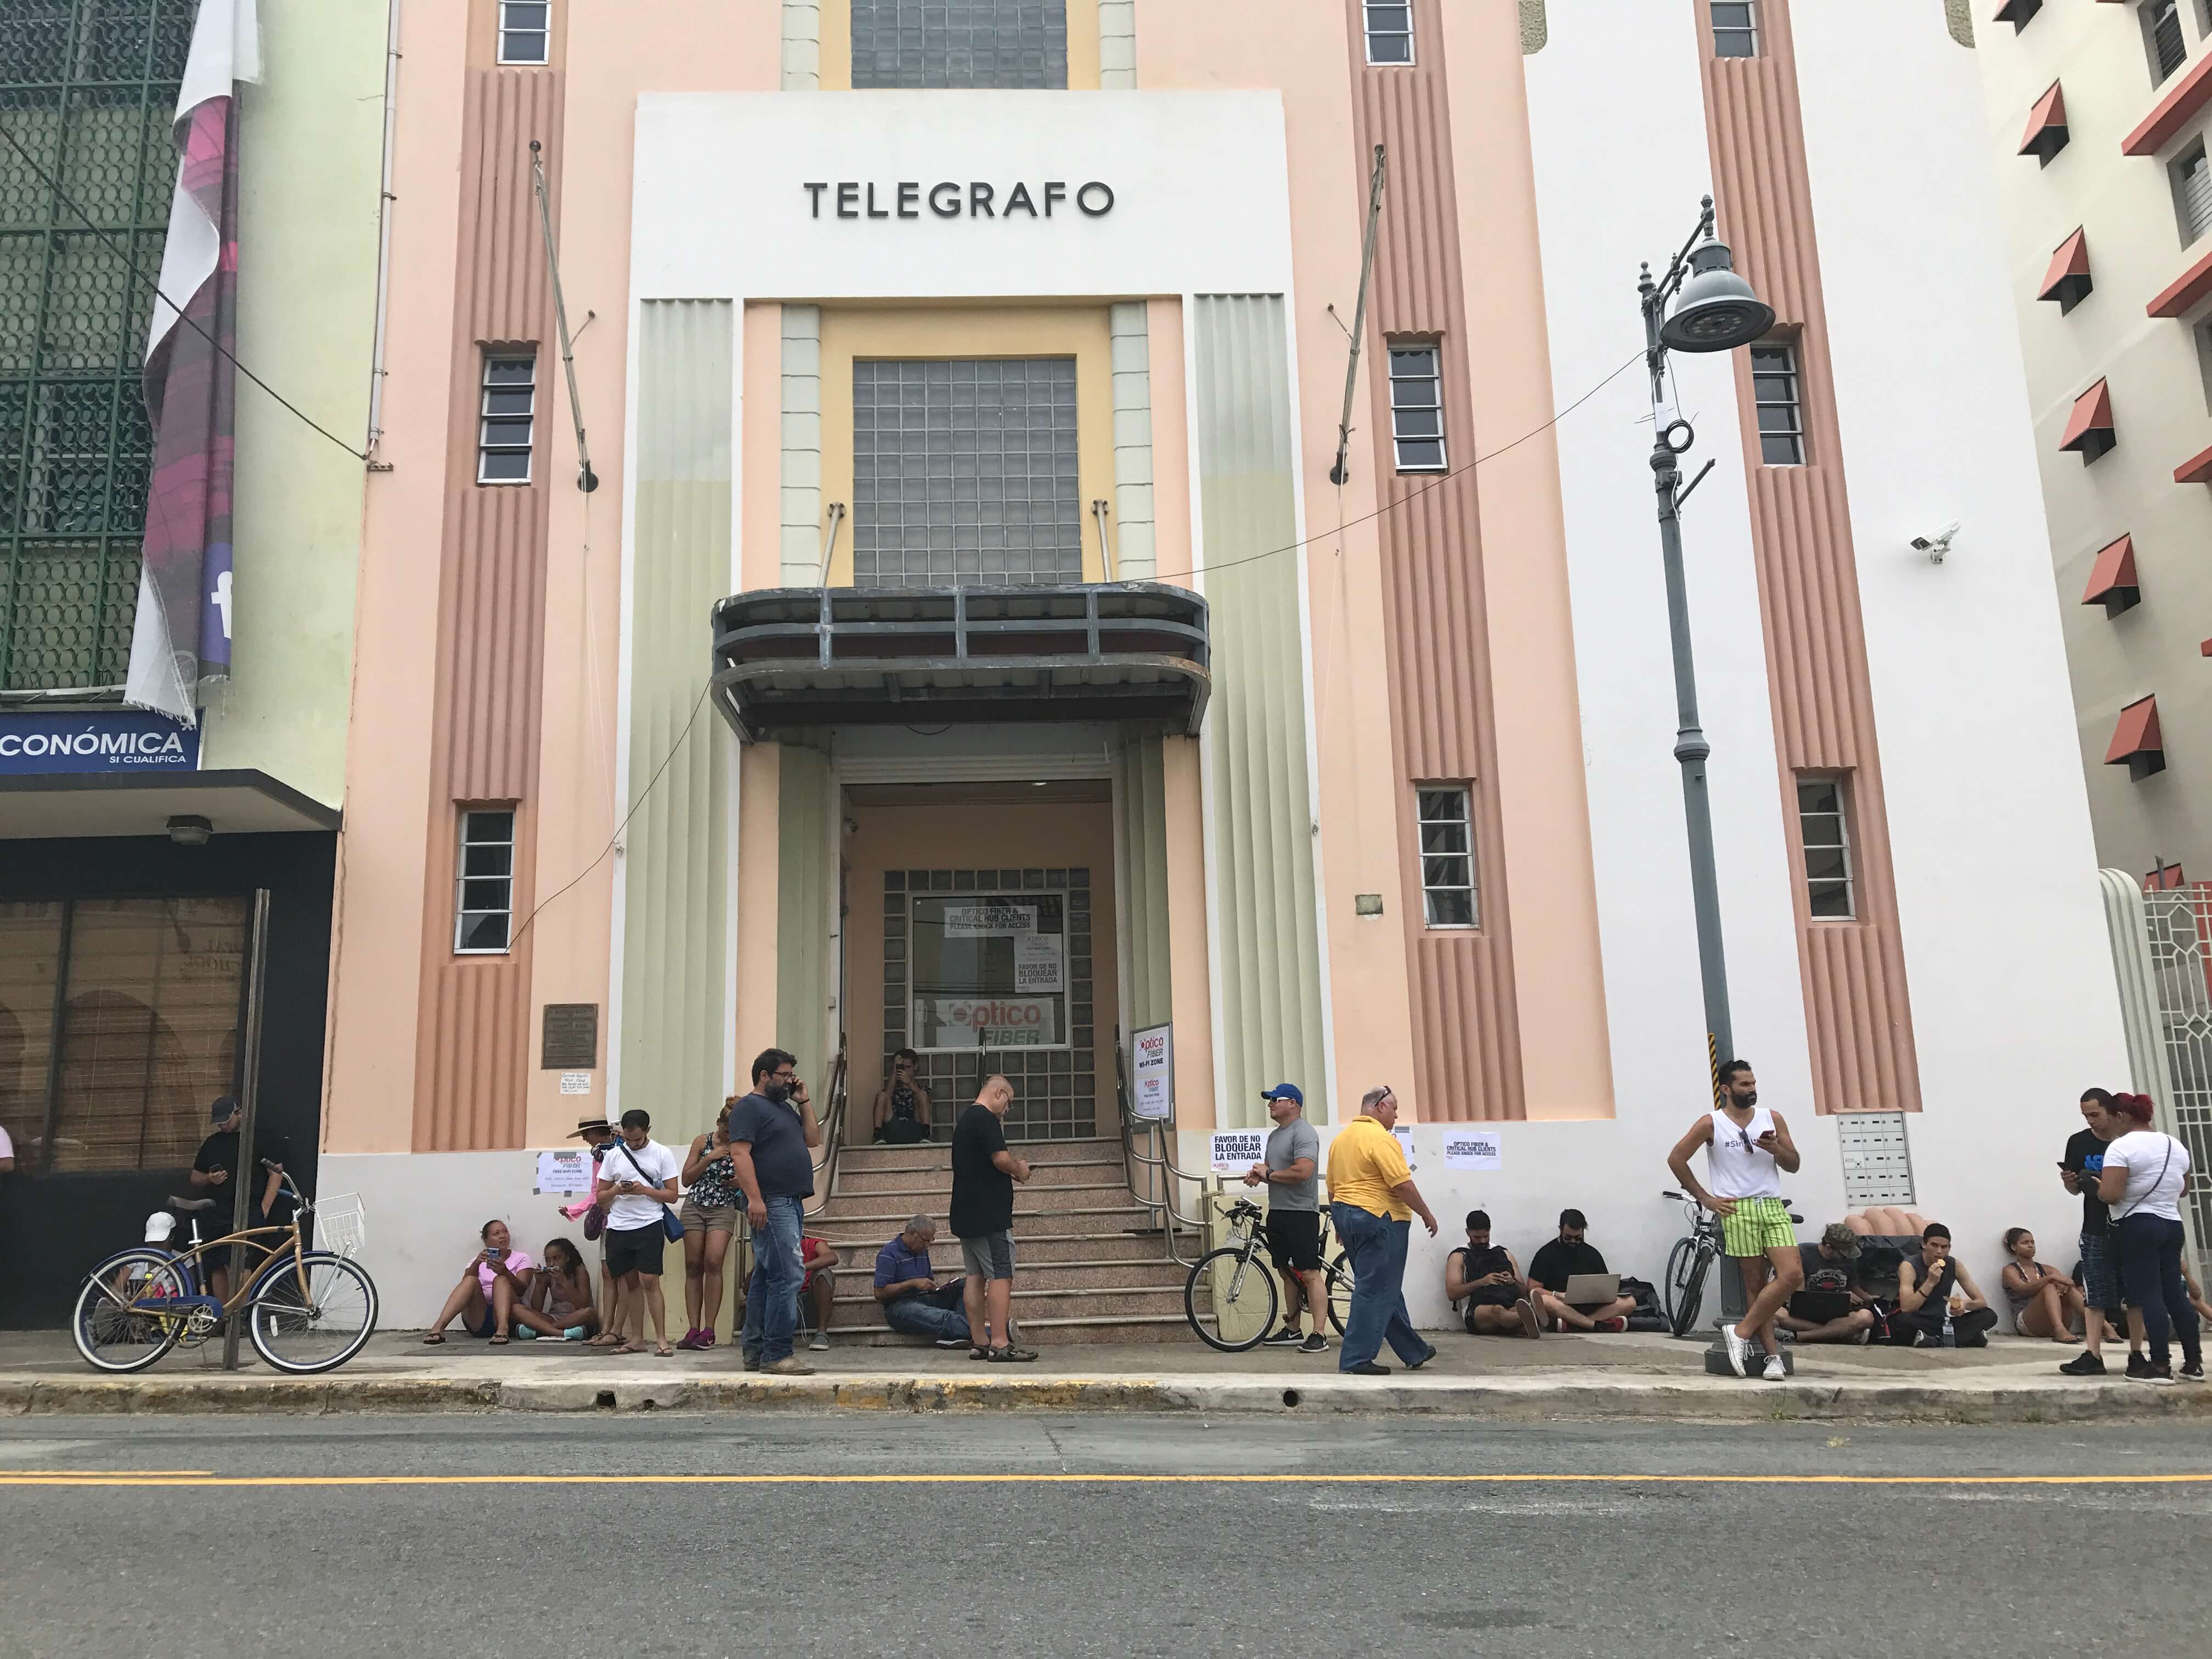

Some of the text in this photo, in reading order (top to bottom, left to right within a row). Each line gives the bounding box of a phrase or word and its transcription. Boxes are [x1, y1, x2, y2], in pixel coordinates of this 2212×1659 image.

[803, 182, 1114, 217] TELEGRAFO
[984, 1028, 1040, 1045] FIBER
[1147, 1048, 1164, 1059] FIBER
[1150, 1058, 1164, 1066] ZONE
[1215, 1143, 1261, 1153] BLOQUEAR
[1227, 1152, 1262, 1160] ENTRADA
